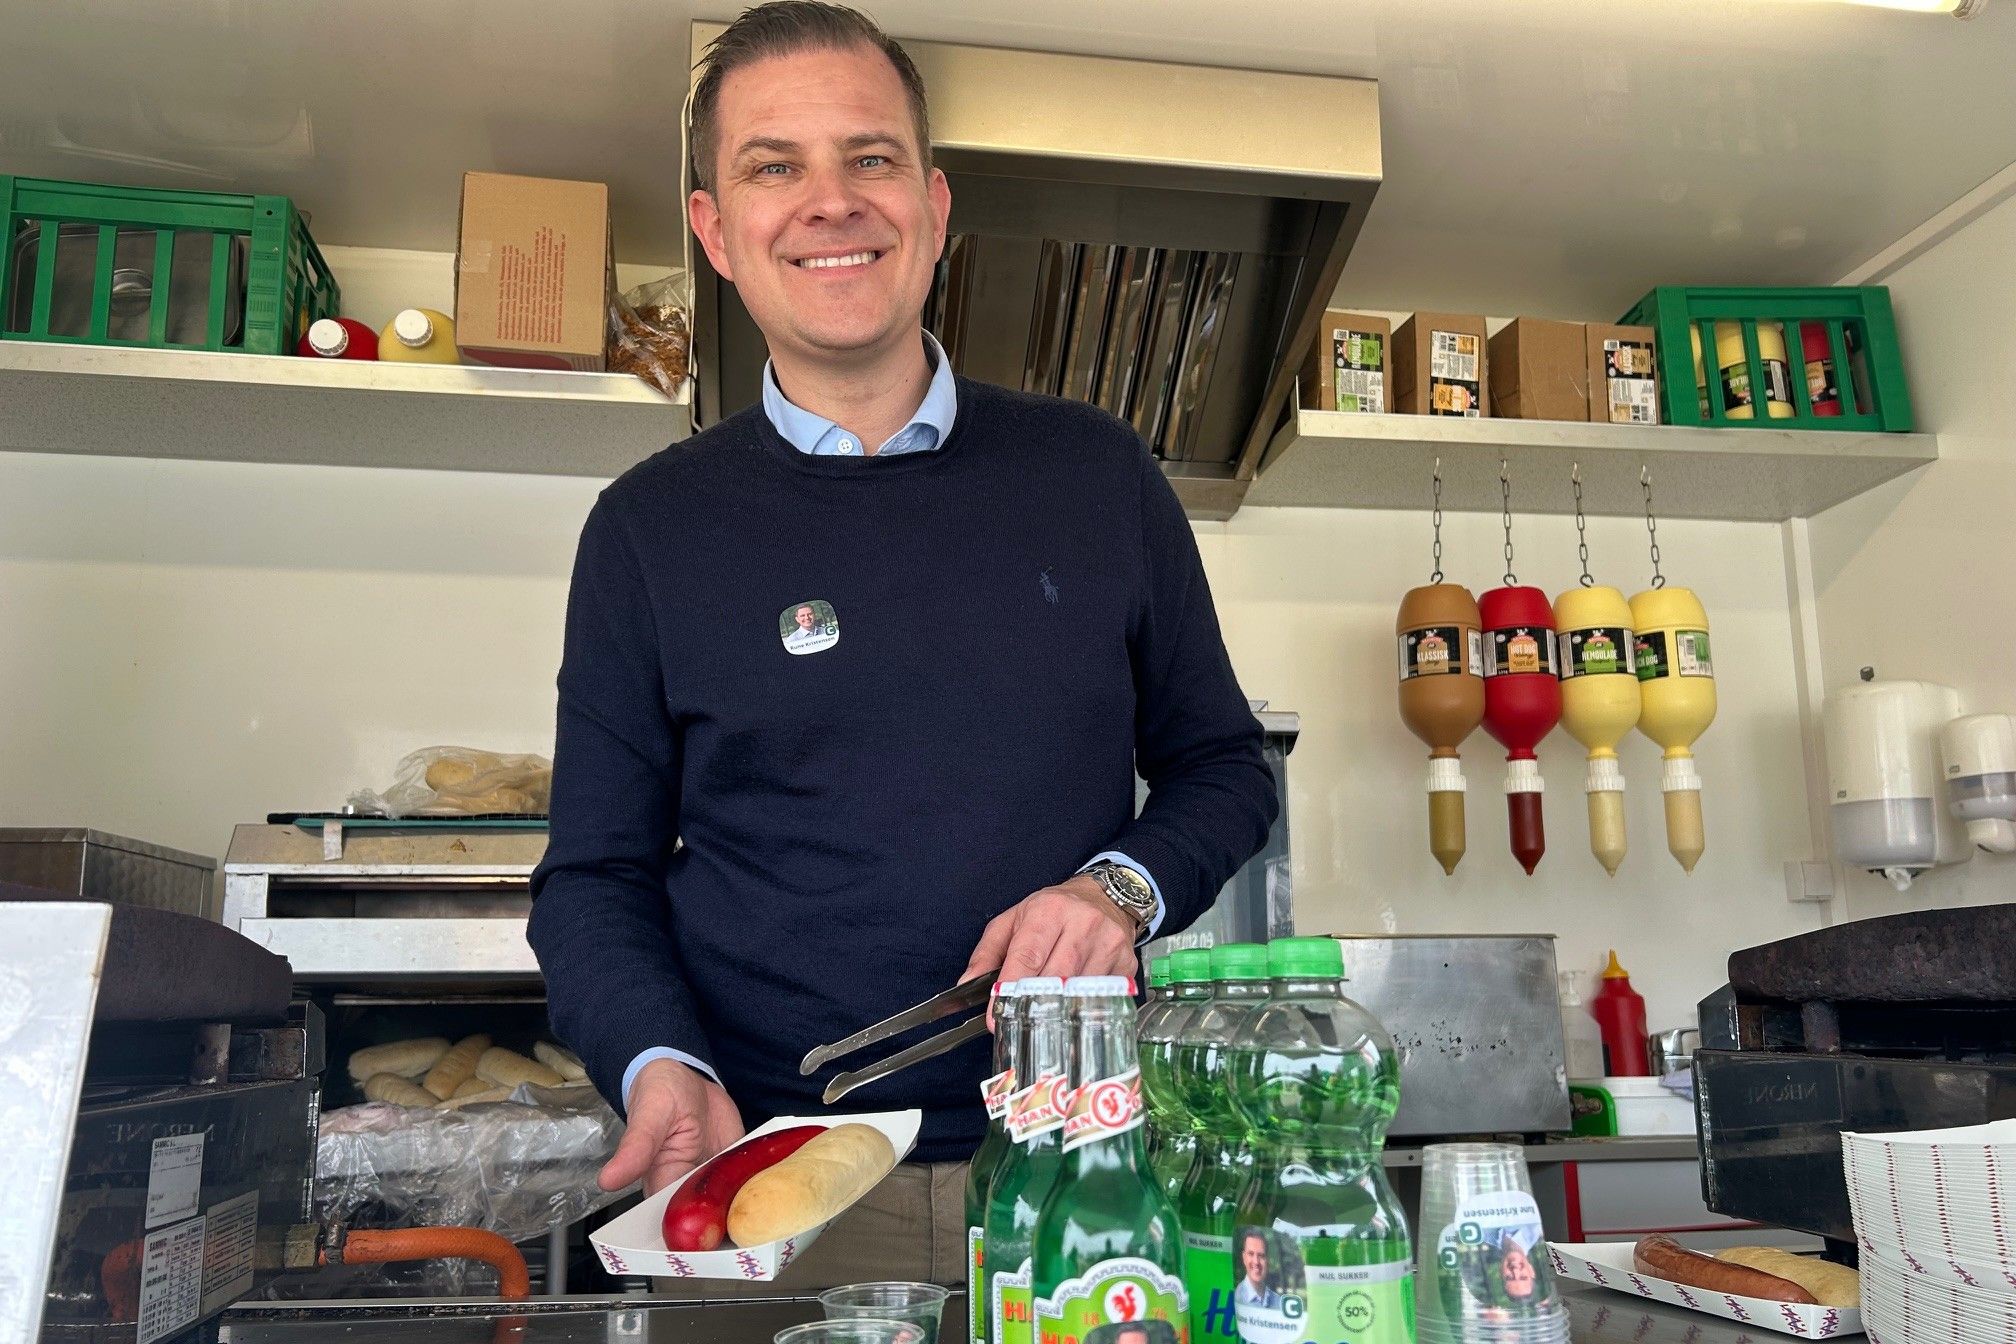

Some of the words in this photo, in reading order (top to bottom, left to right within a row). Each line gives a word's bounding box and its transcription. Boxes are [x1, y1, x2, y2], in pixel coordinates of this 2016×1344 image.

[1417, 649, 1449, 663] KLASSISK
[1463, 1207, 1518, 1218] Kristensen
[1319, 1272, 1335, 1280] NUL
[1338, 1272, 1369, 1280] SUKKER
[1345, 1306, 1369, 1317] 50%
[1249, 1316, 1297, 1331] Kristensen
